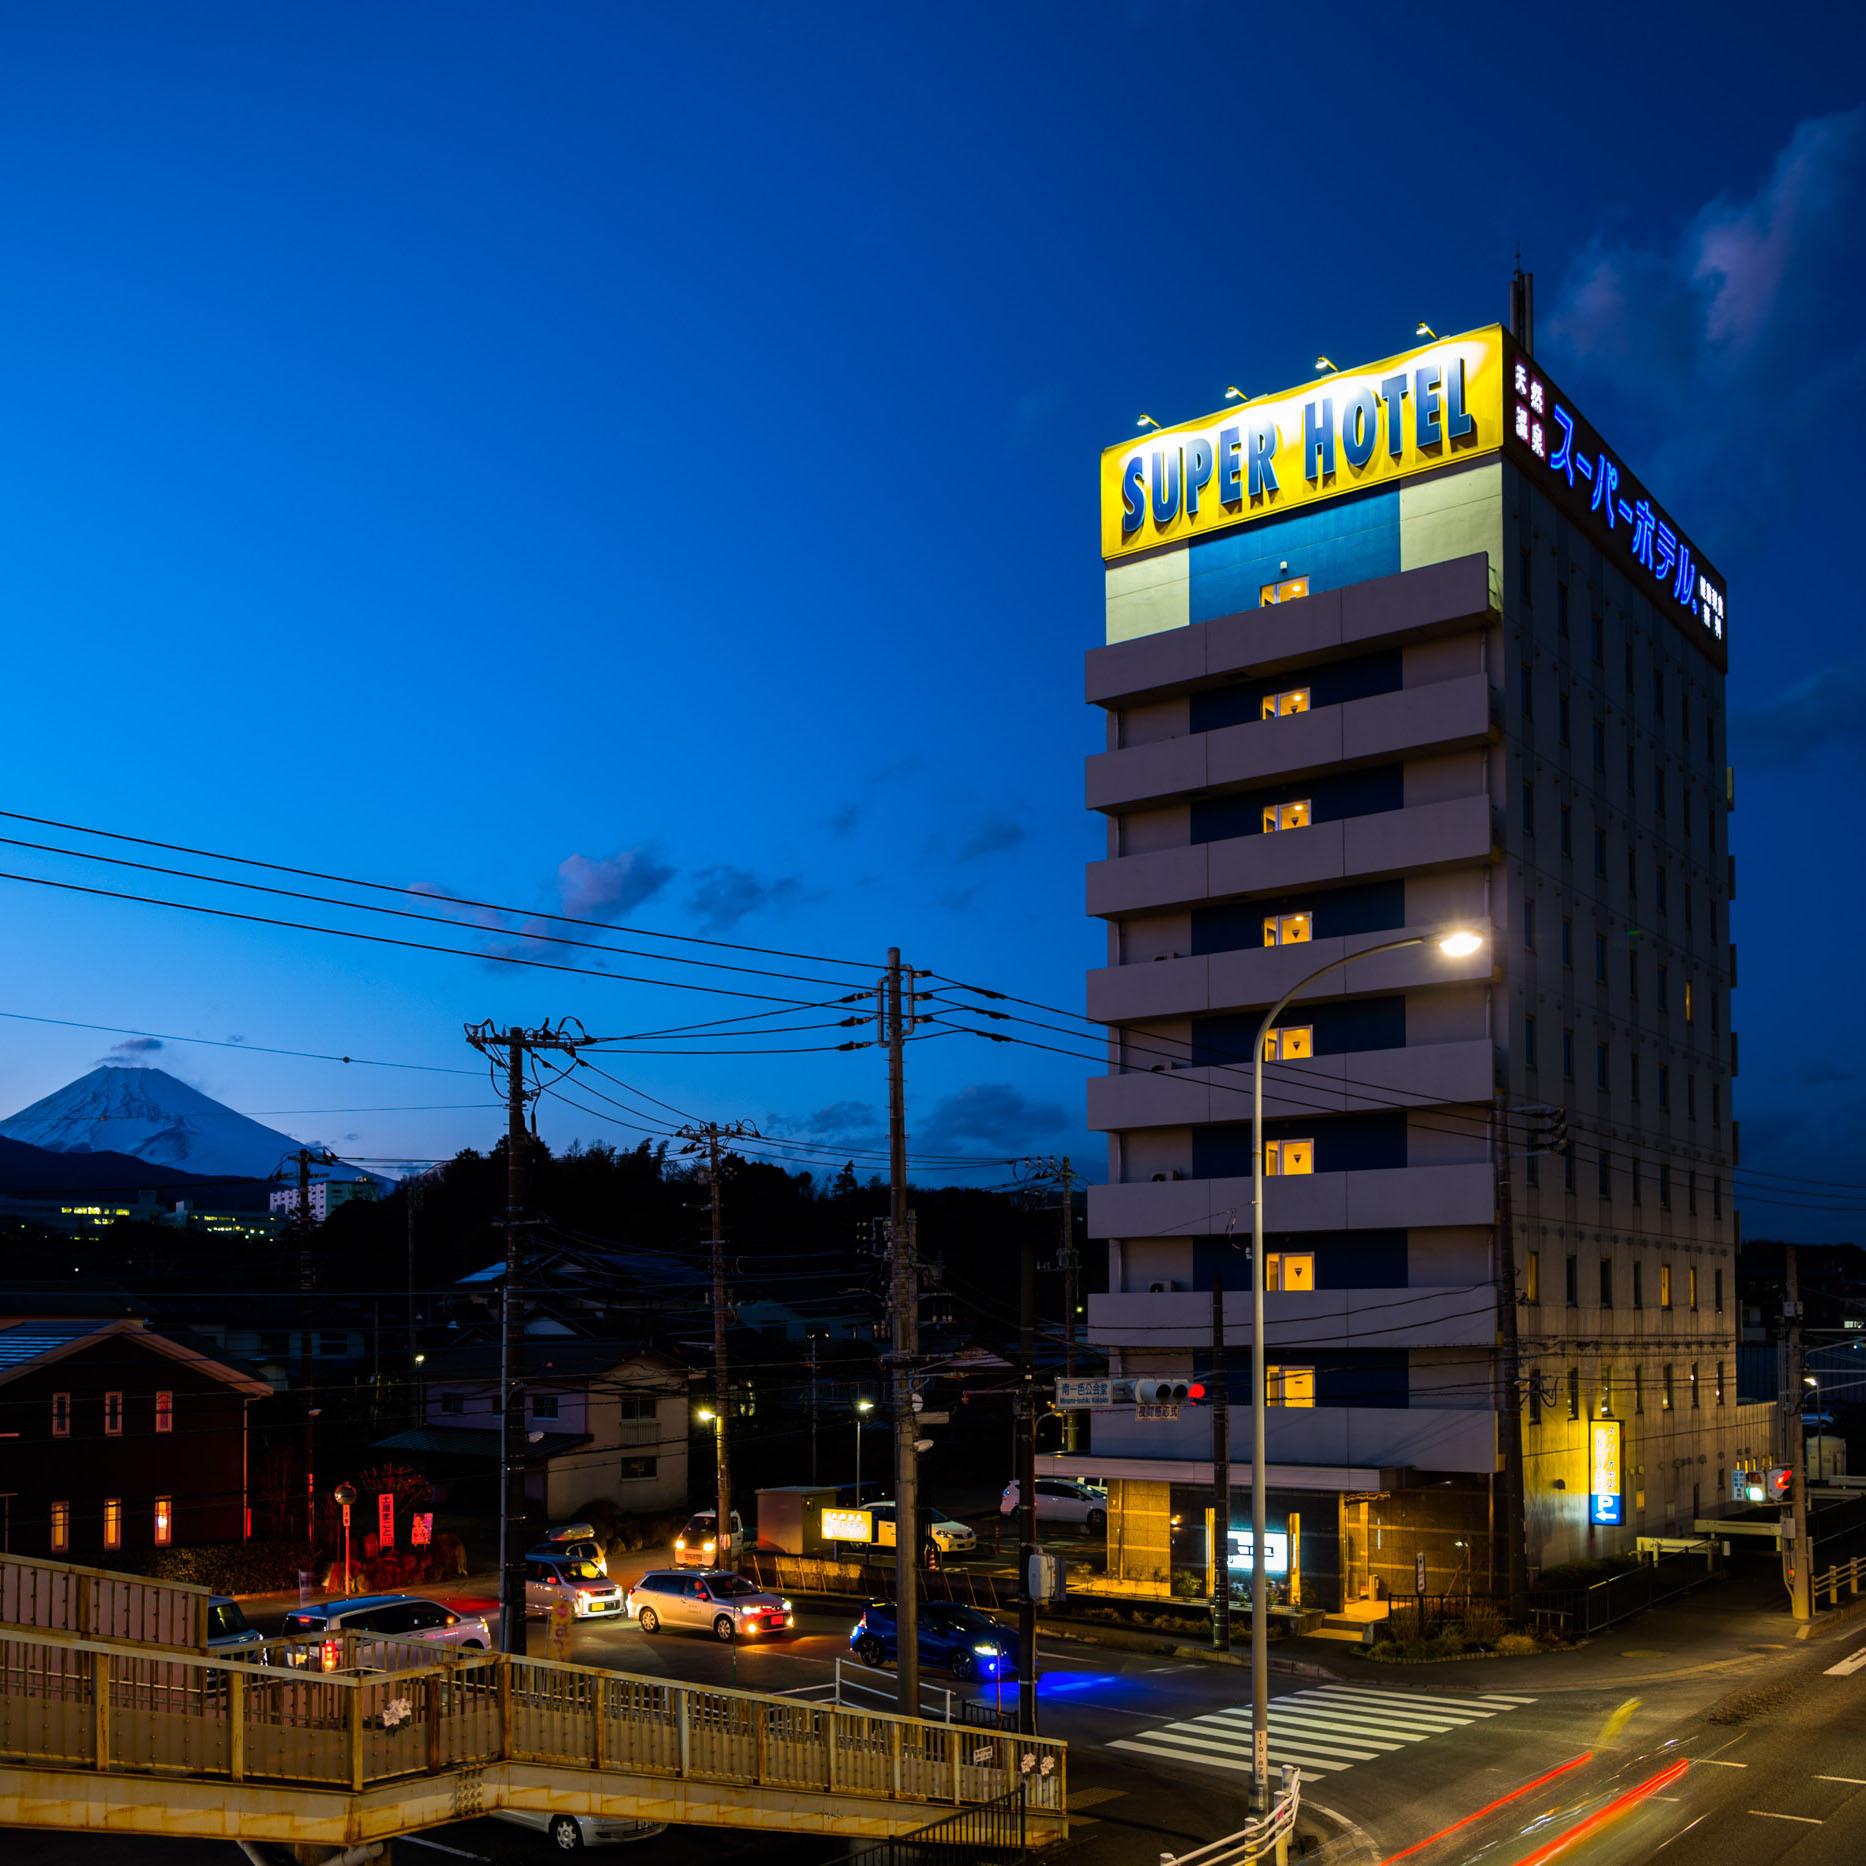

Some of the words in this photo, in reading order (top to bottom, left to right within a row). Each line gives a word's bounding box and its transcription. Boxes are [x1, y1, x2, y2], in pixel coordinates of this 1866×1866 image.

[1123, 419, 1280, 532] SUPER
[1304, 357, 1472, 480] HOTEL
[1515, 364, 1543, 414] 天然
[1550, 403, 1697, 607] スーパーホテル
[1598, 1495, 1613, 1511] P
